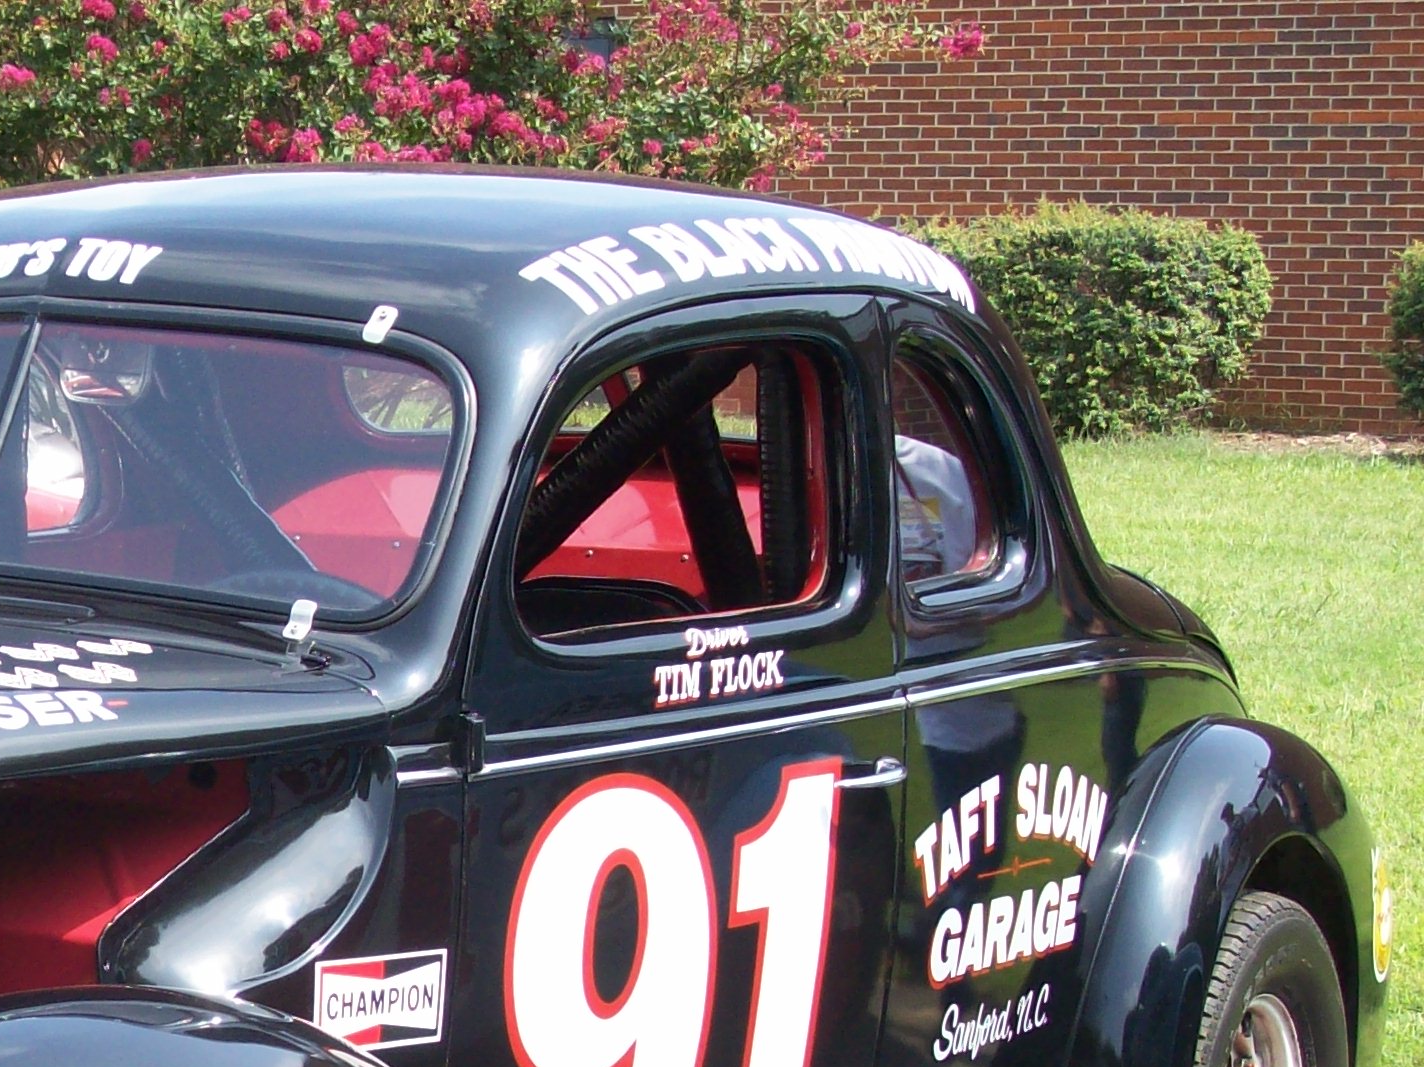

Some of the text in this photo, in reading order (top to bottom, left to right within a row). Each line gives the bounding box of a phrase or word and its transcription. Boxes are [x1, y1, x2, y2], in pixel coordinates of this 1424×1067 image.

[65, 238, 163, 284] TOY
[519, 236, 666, 316] THE
[628, 218, 819, 283] BLACK
[685, 626, 749, 658] Driver
[655, 650, 785, 704] TIM FLOCK
[914, 763, 1108, 903] TAFT SLOAN
[929, 875, 1081, 986] GARAGE
[327, 983, 434, 1020] CHAMPION
